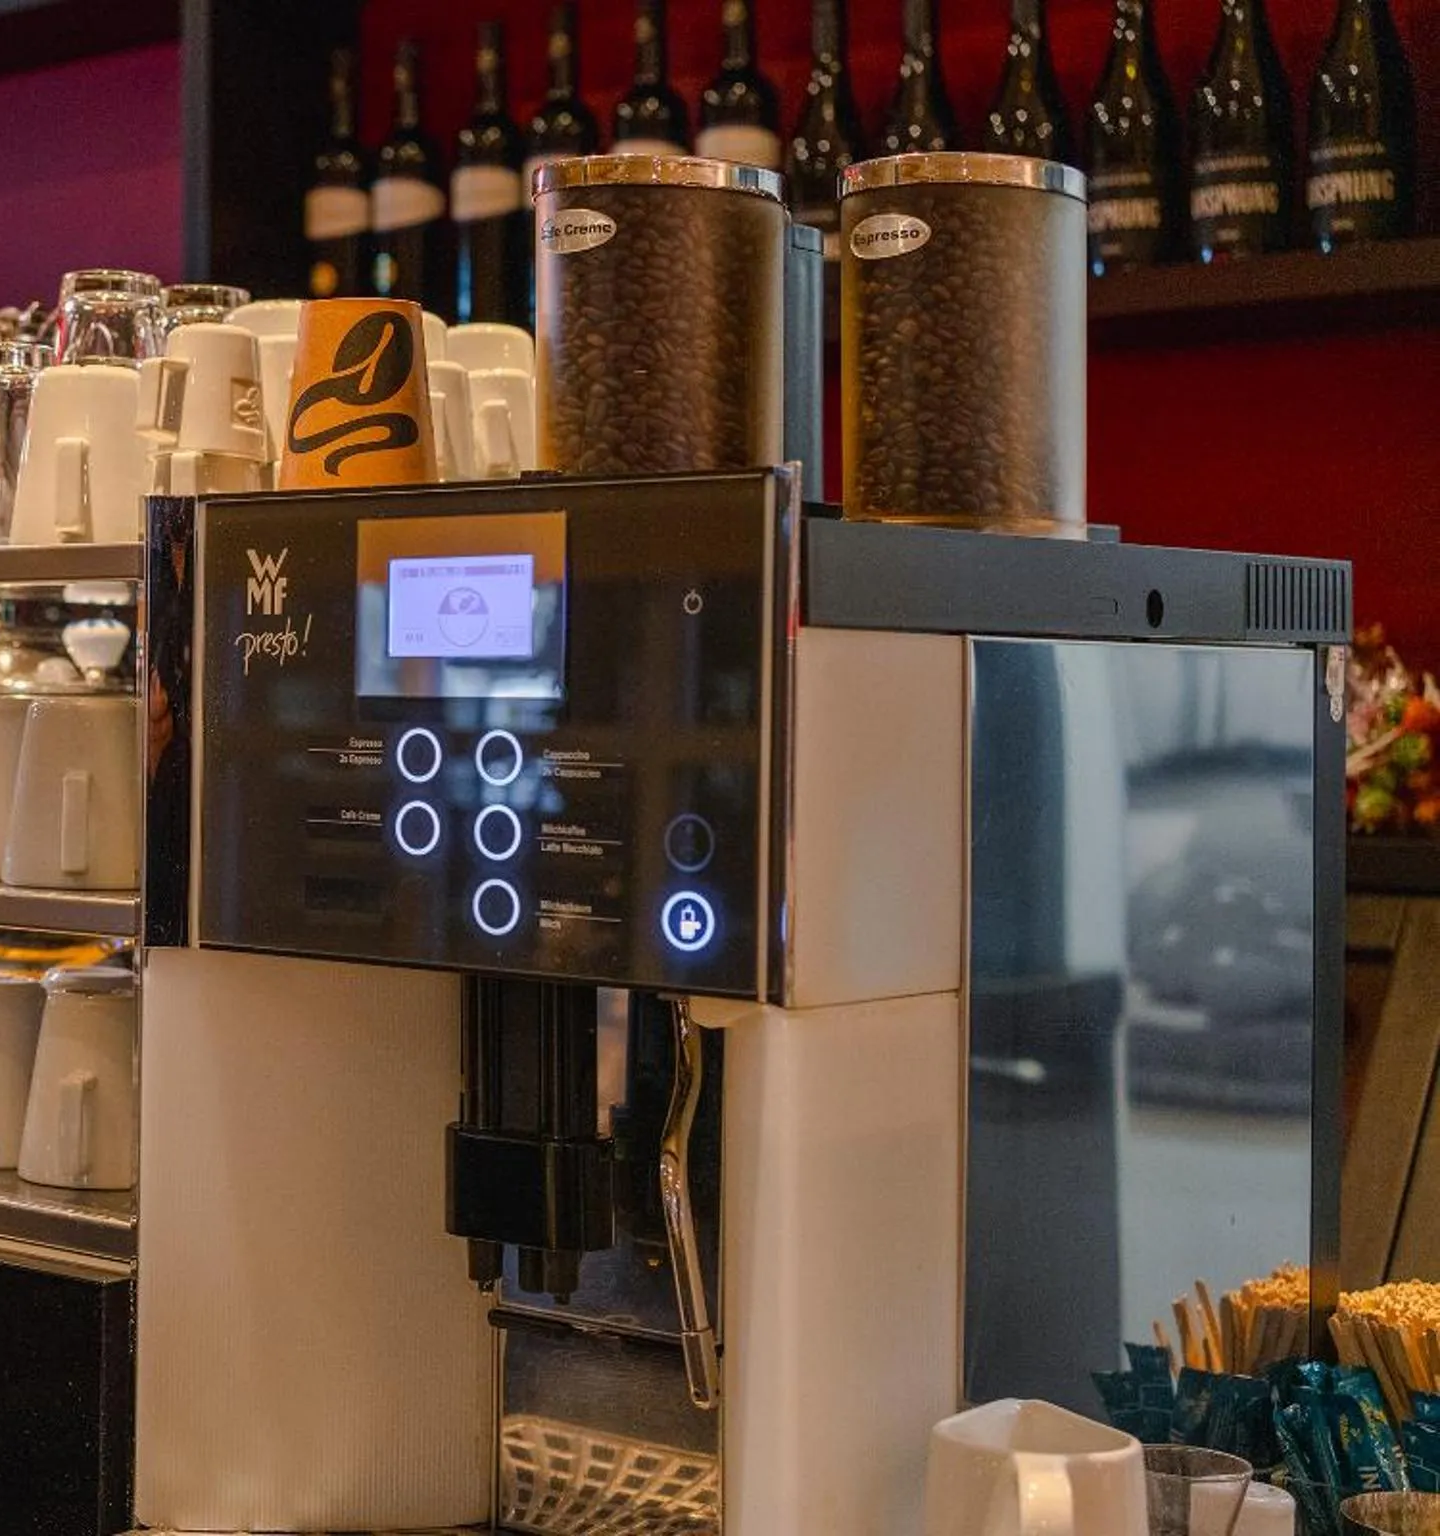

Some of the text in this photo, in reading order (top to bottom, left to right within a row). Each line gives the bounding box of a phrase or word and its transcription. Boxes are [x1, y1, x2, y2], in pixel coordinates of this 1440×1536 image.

[564, 223, 612, 236] Creme
[854, 229, 920, 247] Espresso
[246, 548, 288, 615] WMF
[234, 613, 312, 676] presto!
